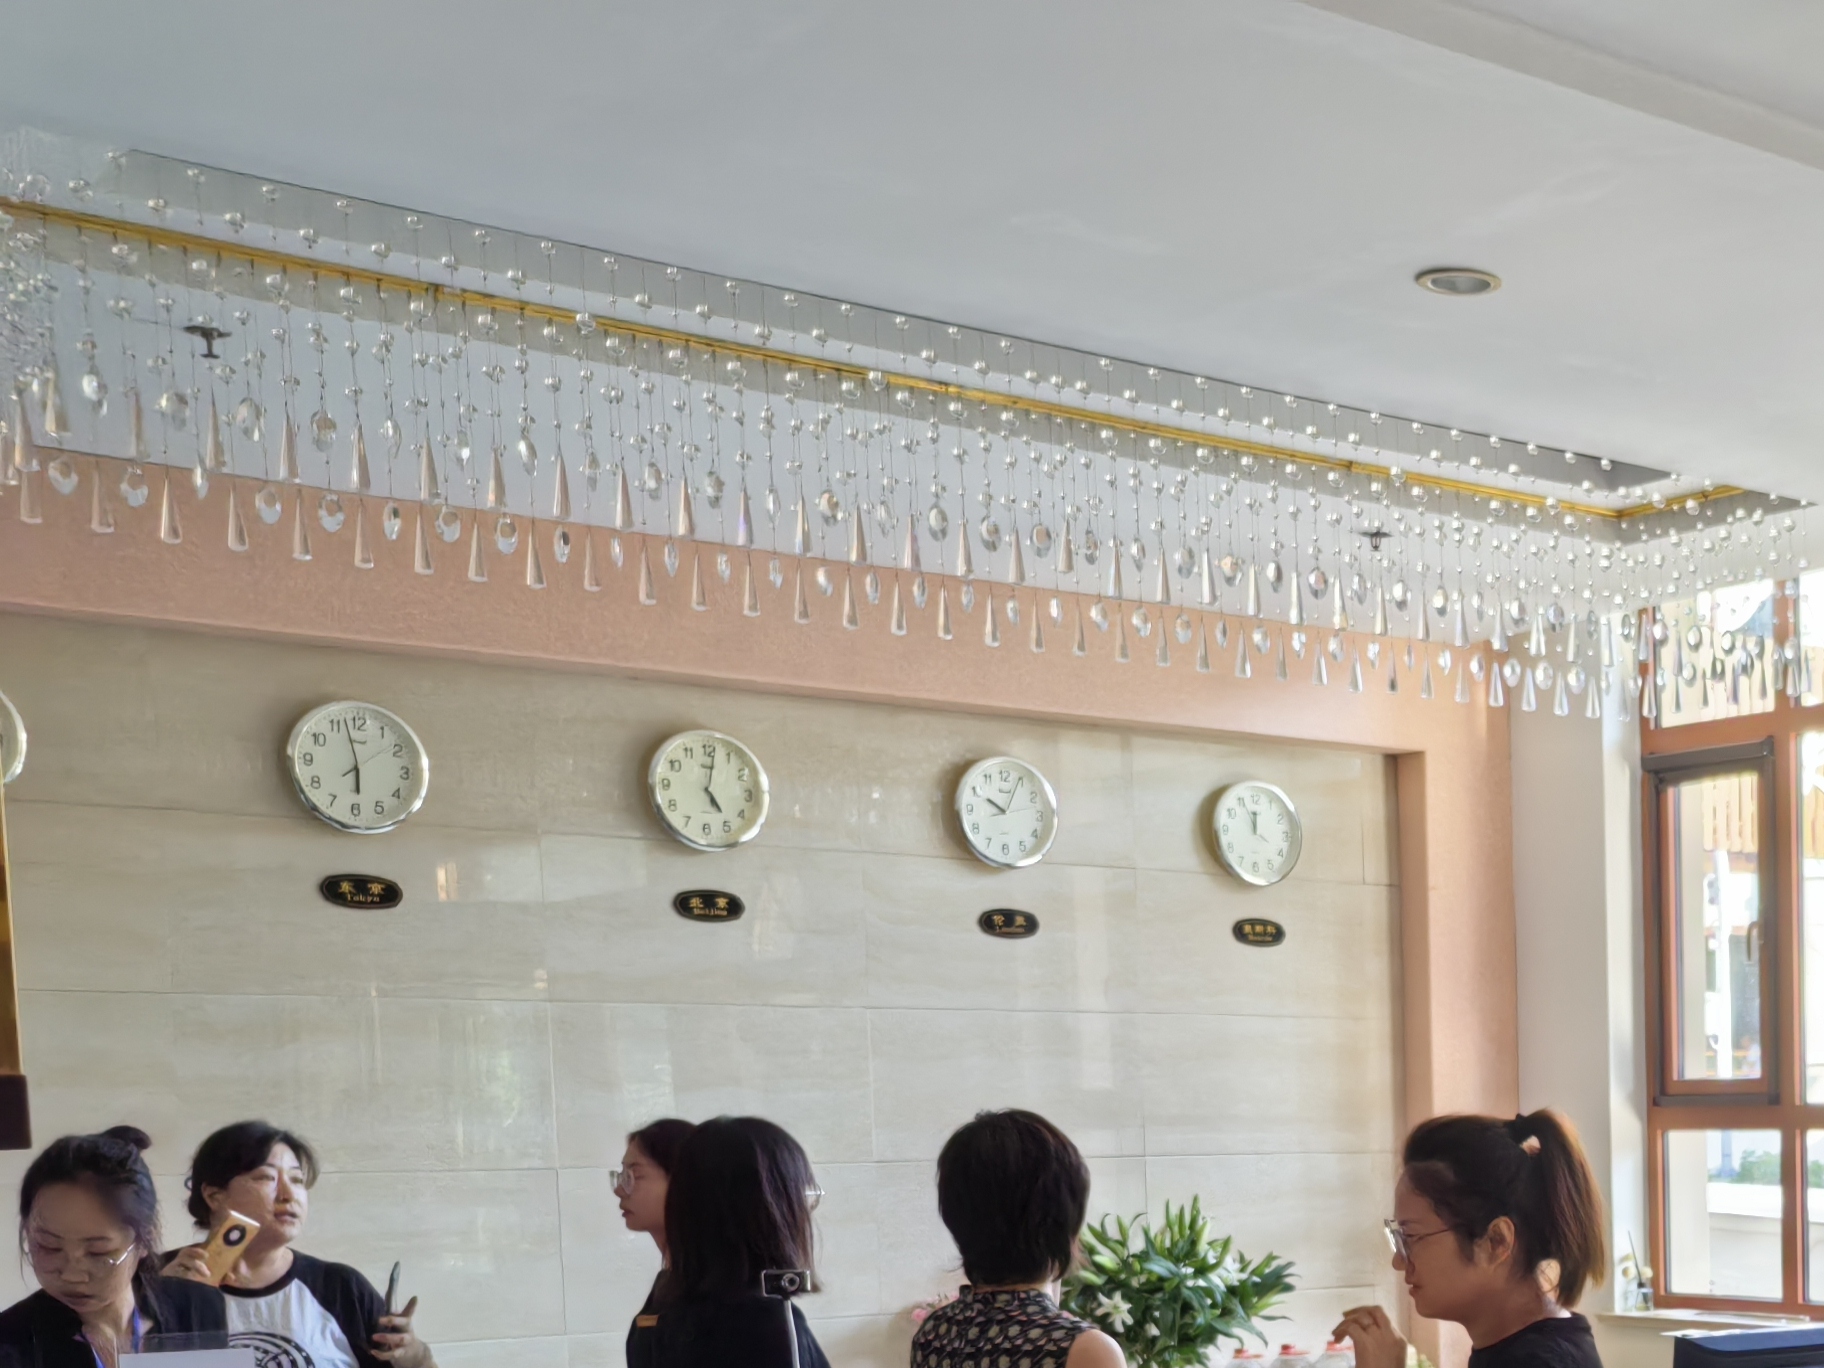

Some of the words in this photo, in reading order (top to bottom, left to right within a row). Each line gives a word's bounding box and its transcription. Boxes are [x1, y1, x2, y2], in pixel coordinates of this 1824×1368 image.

[329, 718, 340, 733] 11
[352, 715, 367, 731] 12
[311, 732, 326, 747] 10
[393, 744, 403, 758] 2
[303, 752, 313, 766] 9
[400, 766, 410, 780] 3
[311, 775, 321, 789] 8
[328, 793, 338, 807] 7
[391, 787, 401, 799] 4
[351, 803, 361, 817] 6
[374, 801, 384, 815] 5
[338, 881, 386, 894] 东京
[689, 897, 729, 908] 北京
